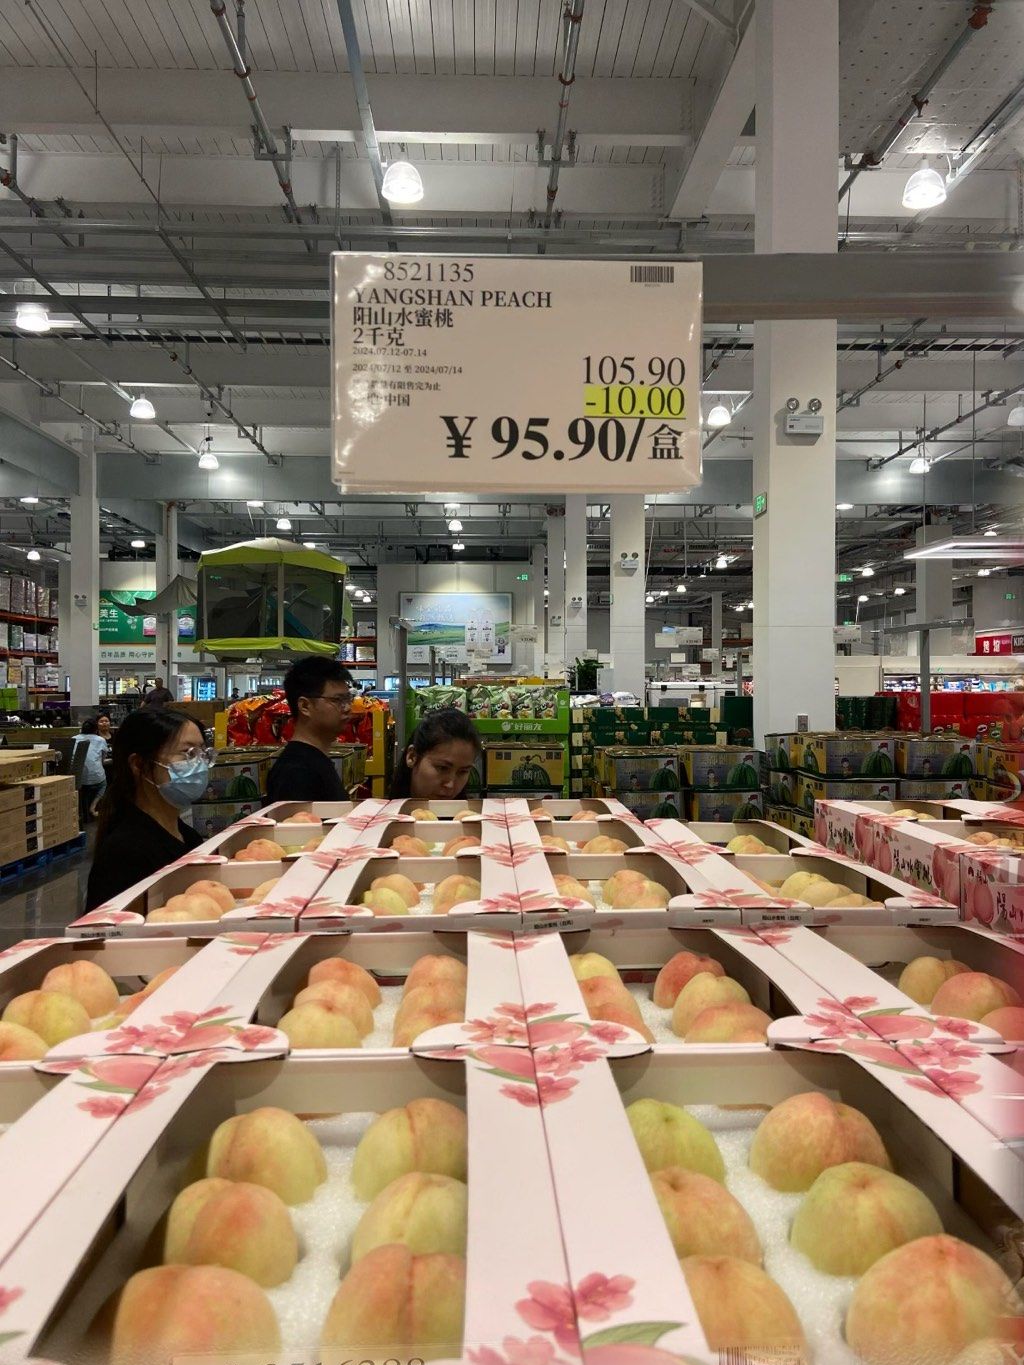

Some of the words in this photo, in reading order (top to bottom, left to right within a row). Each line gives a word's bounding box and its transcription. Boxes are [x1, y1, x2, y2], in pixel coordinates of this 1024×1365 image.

[383, 261, 475, 283] 8521135
[353, 287, 474, 308] YANGSHAN
[481, 291, 553, 308] PEACH
[352, 307, 454, 328] 阳山水蜜桃
[352, 327, 406, 347] 2千克
[582, 354, 687, 387] 105.90
[585, 386, 686, 416] -10.00
[491, 415, 685, 462] 95.90/盒
[513, 722, 543, 732] 好丽友
